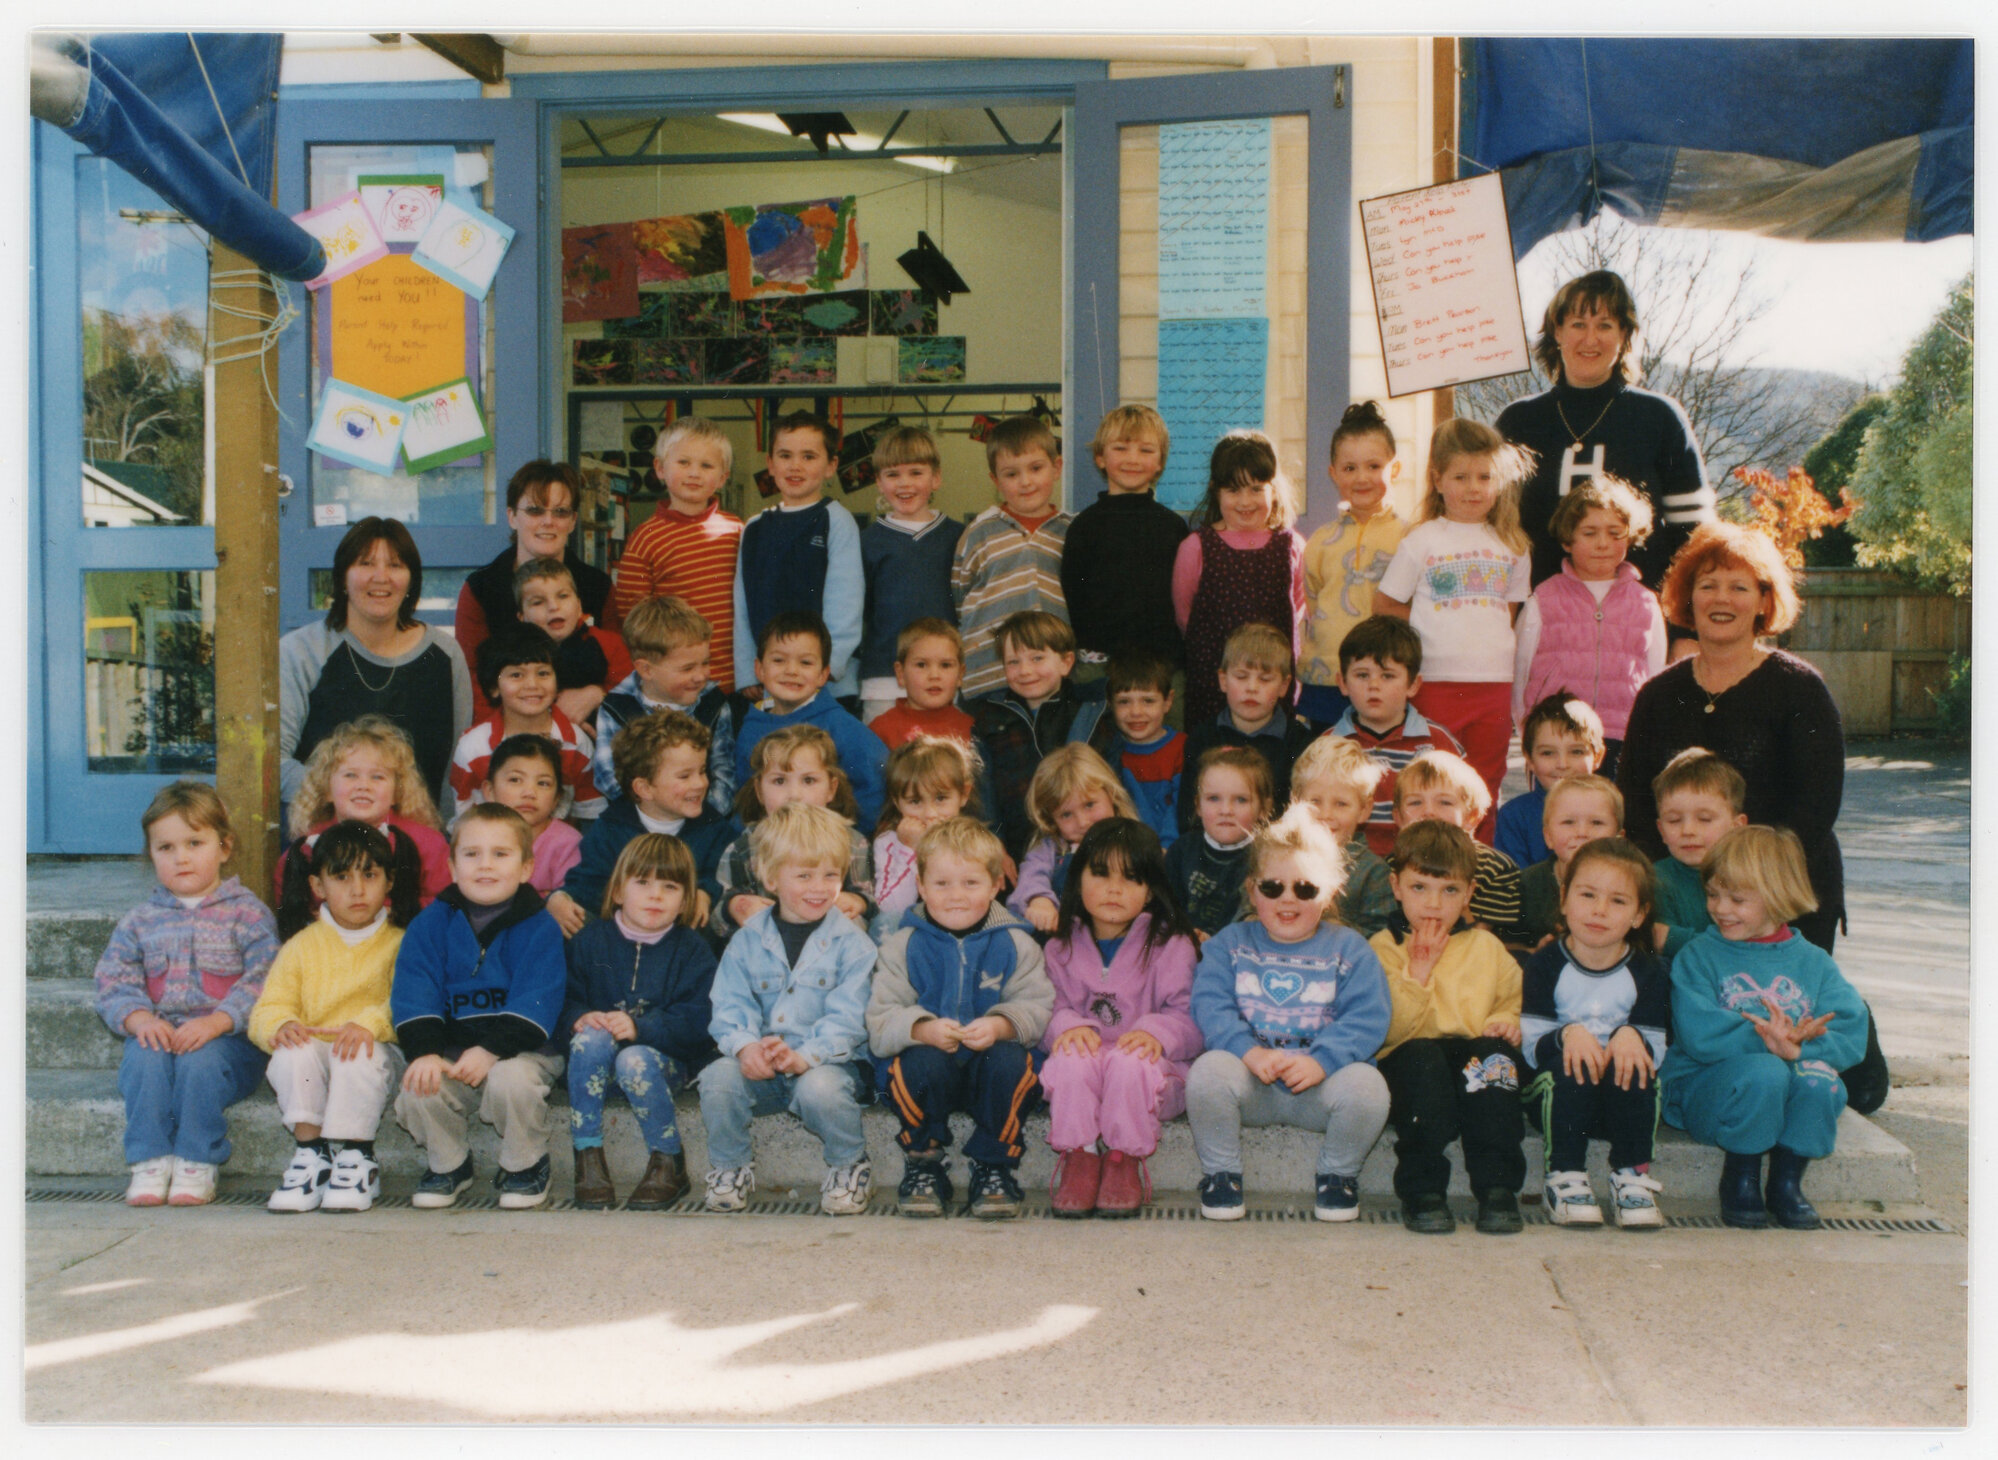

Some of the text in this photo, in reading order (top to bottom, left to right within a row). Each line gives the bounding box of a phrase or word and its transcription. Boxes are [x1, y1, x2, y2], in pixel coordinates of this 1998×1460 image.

[353, 272, 440, 290] Your CHILDREN
[357, 291, 382, 302] need
[1559, 444, 1604, 496] H
